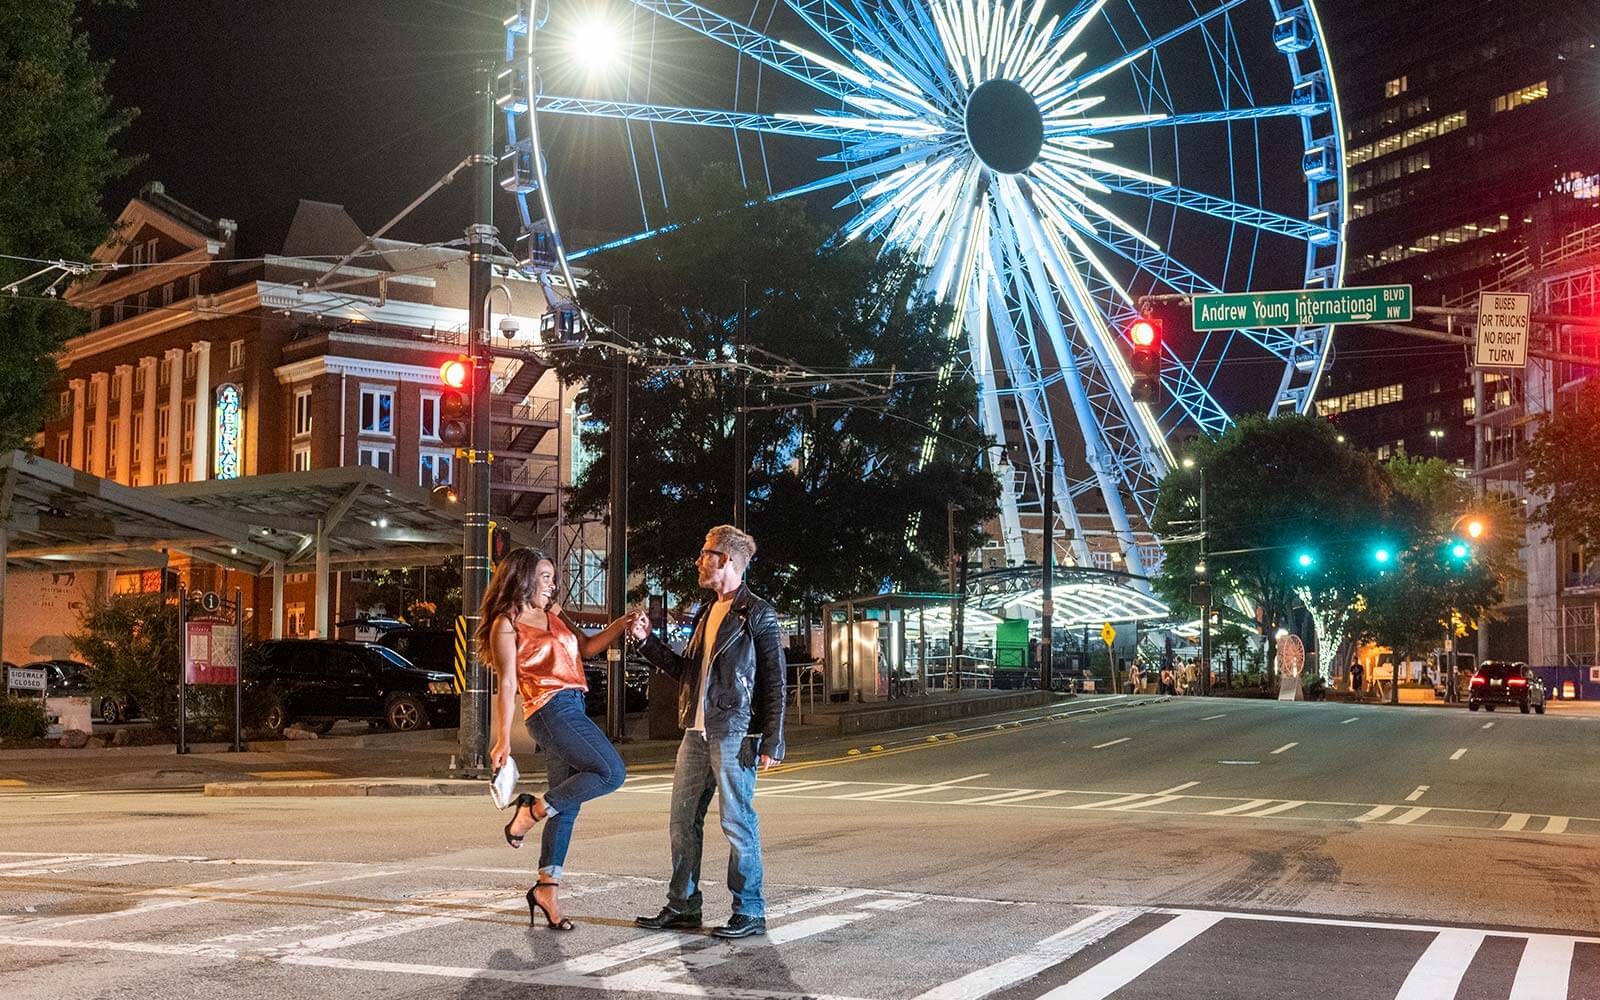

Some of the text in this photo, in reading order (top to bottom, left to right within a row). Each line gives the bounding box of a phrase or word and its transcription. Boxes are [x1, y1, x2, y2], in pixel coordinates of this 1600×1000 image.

[1383, 289, 1405, 301] BLVD
[1201, 295, 1377, 322] Andrew Young International
[1494, 297, 1515, 310] BUSES
[1386, 306, 1401, 318] NW
[1481, 314, 1526, 328] OR TRUCKS
[1484, 332, 1521, 345] NO RIGHT
[1488, 349, 1514, 362] TURN
[11, 671, 44, 679] SIDEWALK
